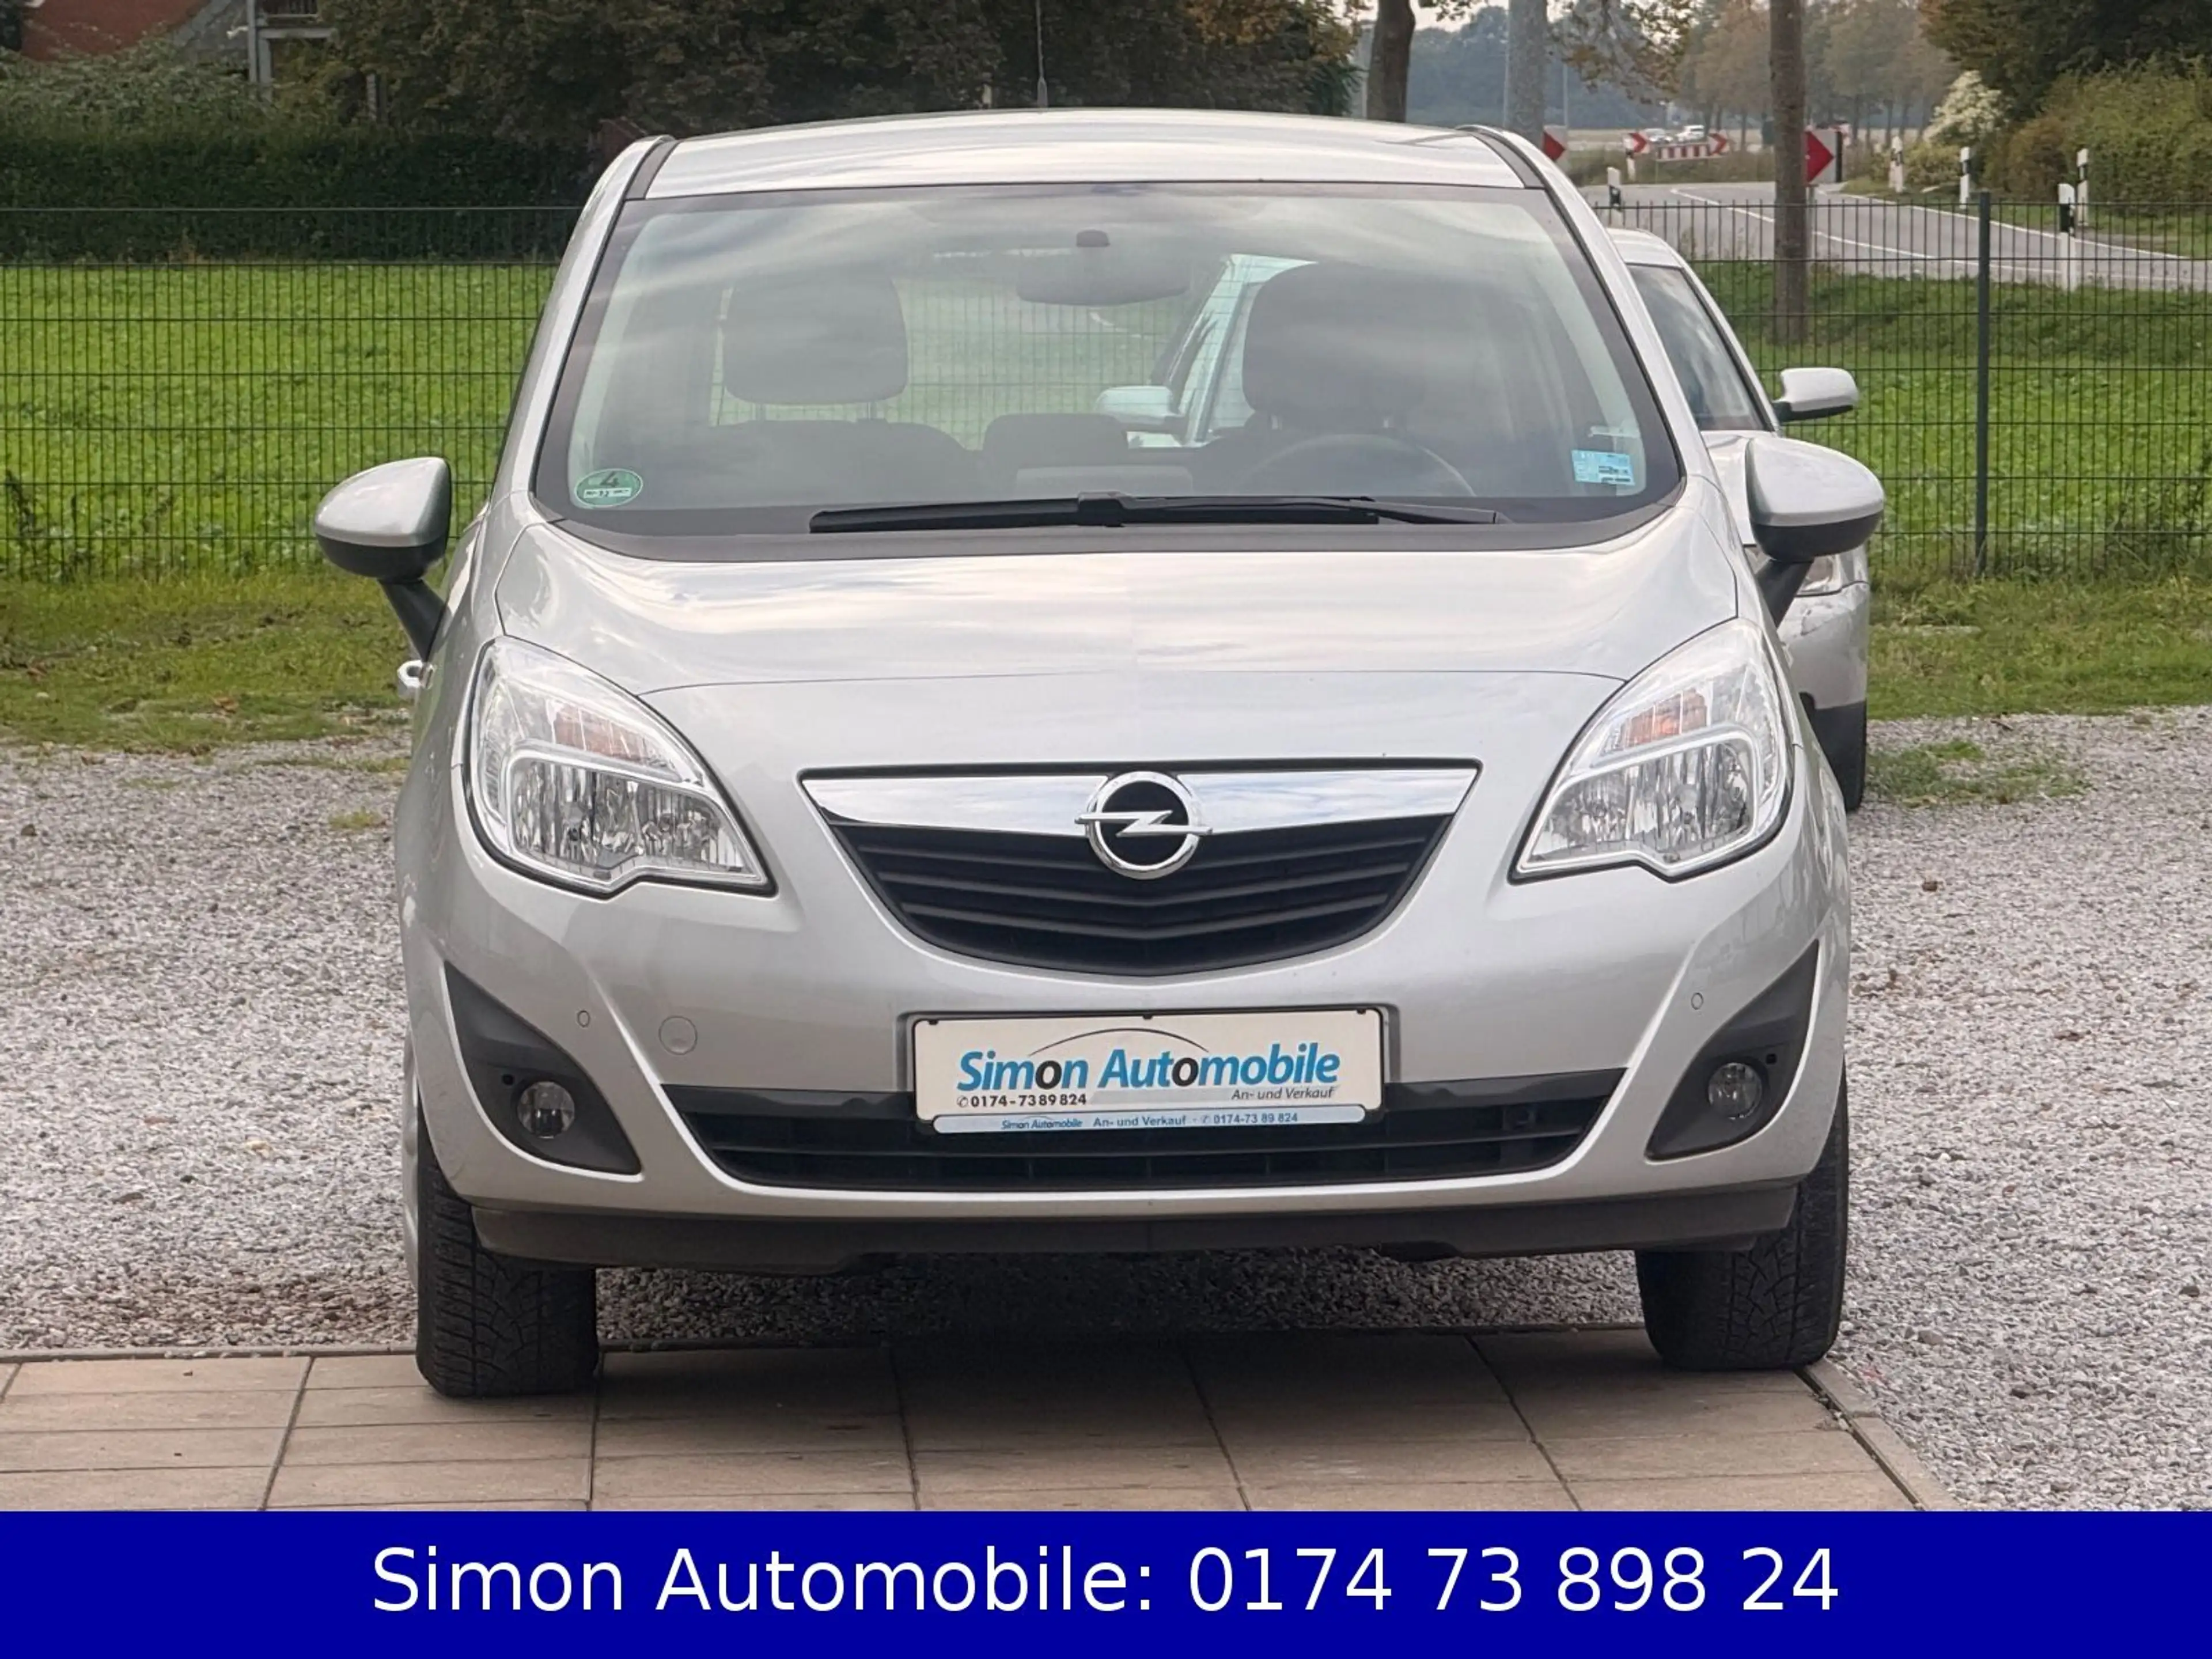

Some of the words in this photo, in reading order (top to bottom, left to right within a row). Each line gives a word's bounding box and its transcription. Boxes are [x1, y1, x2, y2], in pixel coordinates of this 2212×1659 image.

[957, 1051, 1089, 1092] Simon
[1099, 1043, 1339, 1089] Automobile
[1231, 1089, 1253, 1100] An-
[1257, 1088, 1282, 1100] und
[1286, 1086, 1334, 1099] Verkauf
[1001, 1119, 1029, 1130] Simon
[1031, 1118, 1082, 1129] Automobile
[1093, 1117, 1113, 1127] An-
[1116, 1116, 1139, 1127] und
[1141, 1115, 1187, 1126] Verkauf
